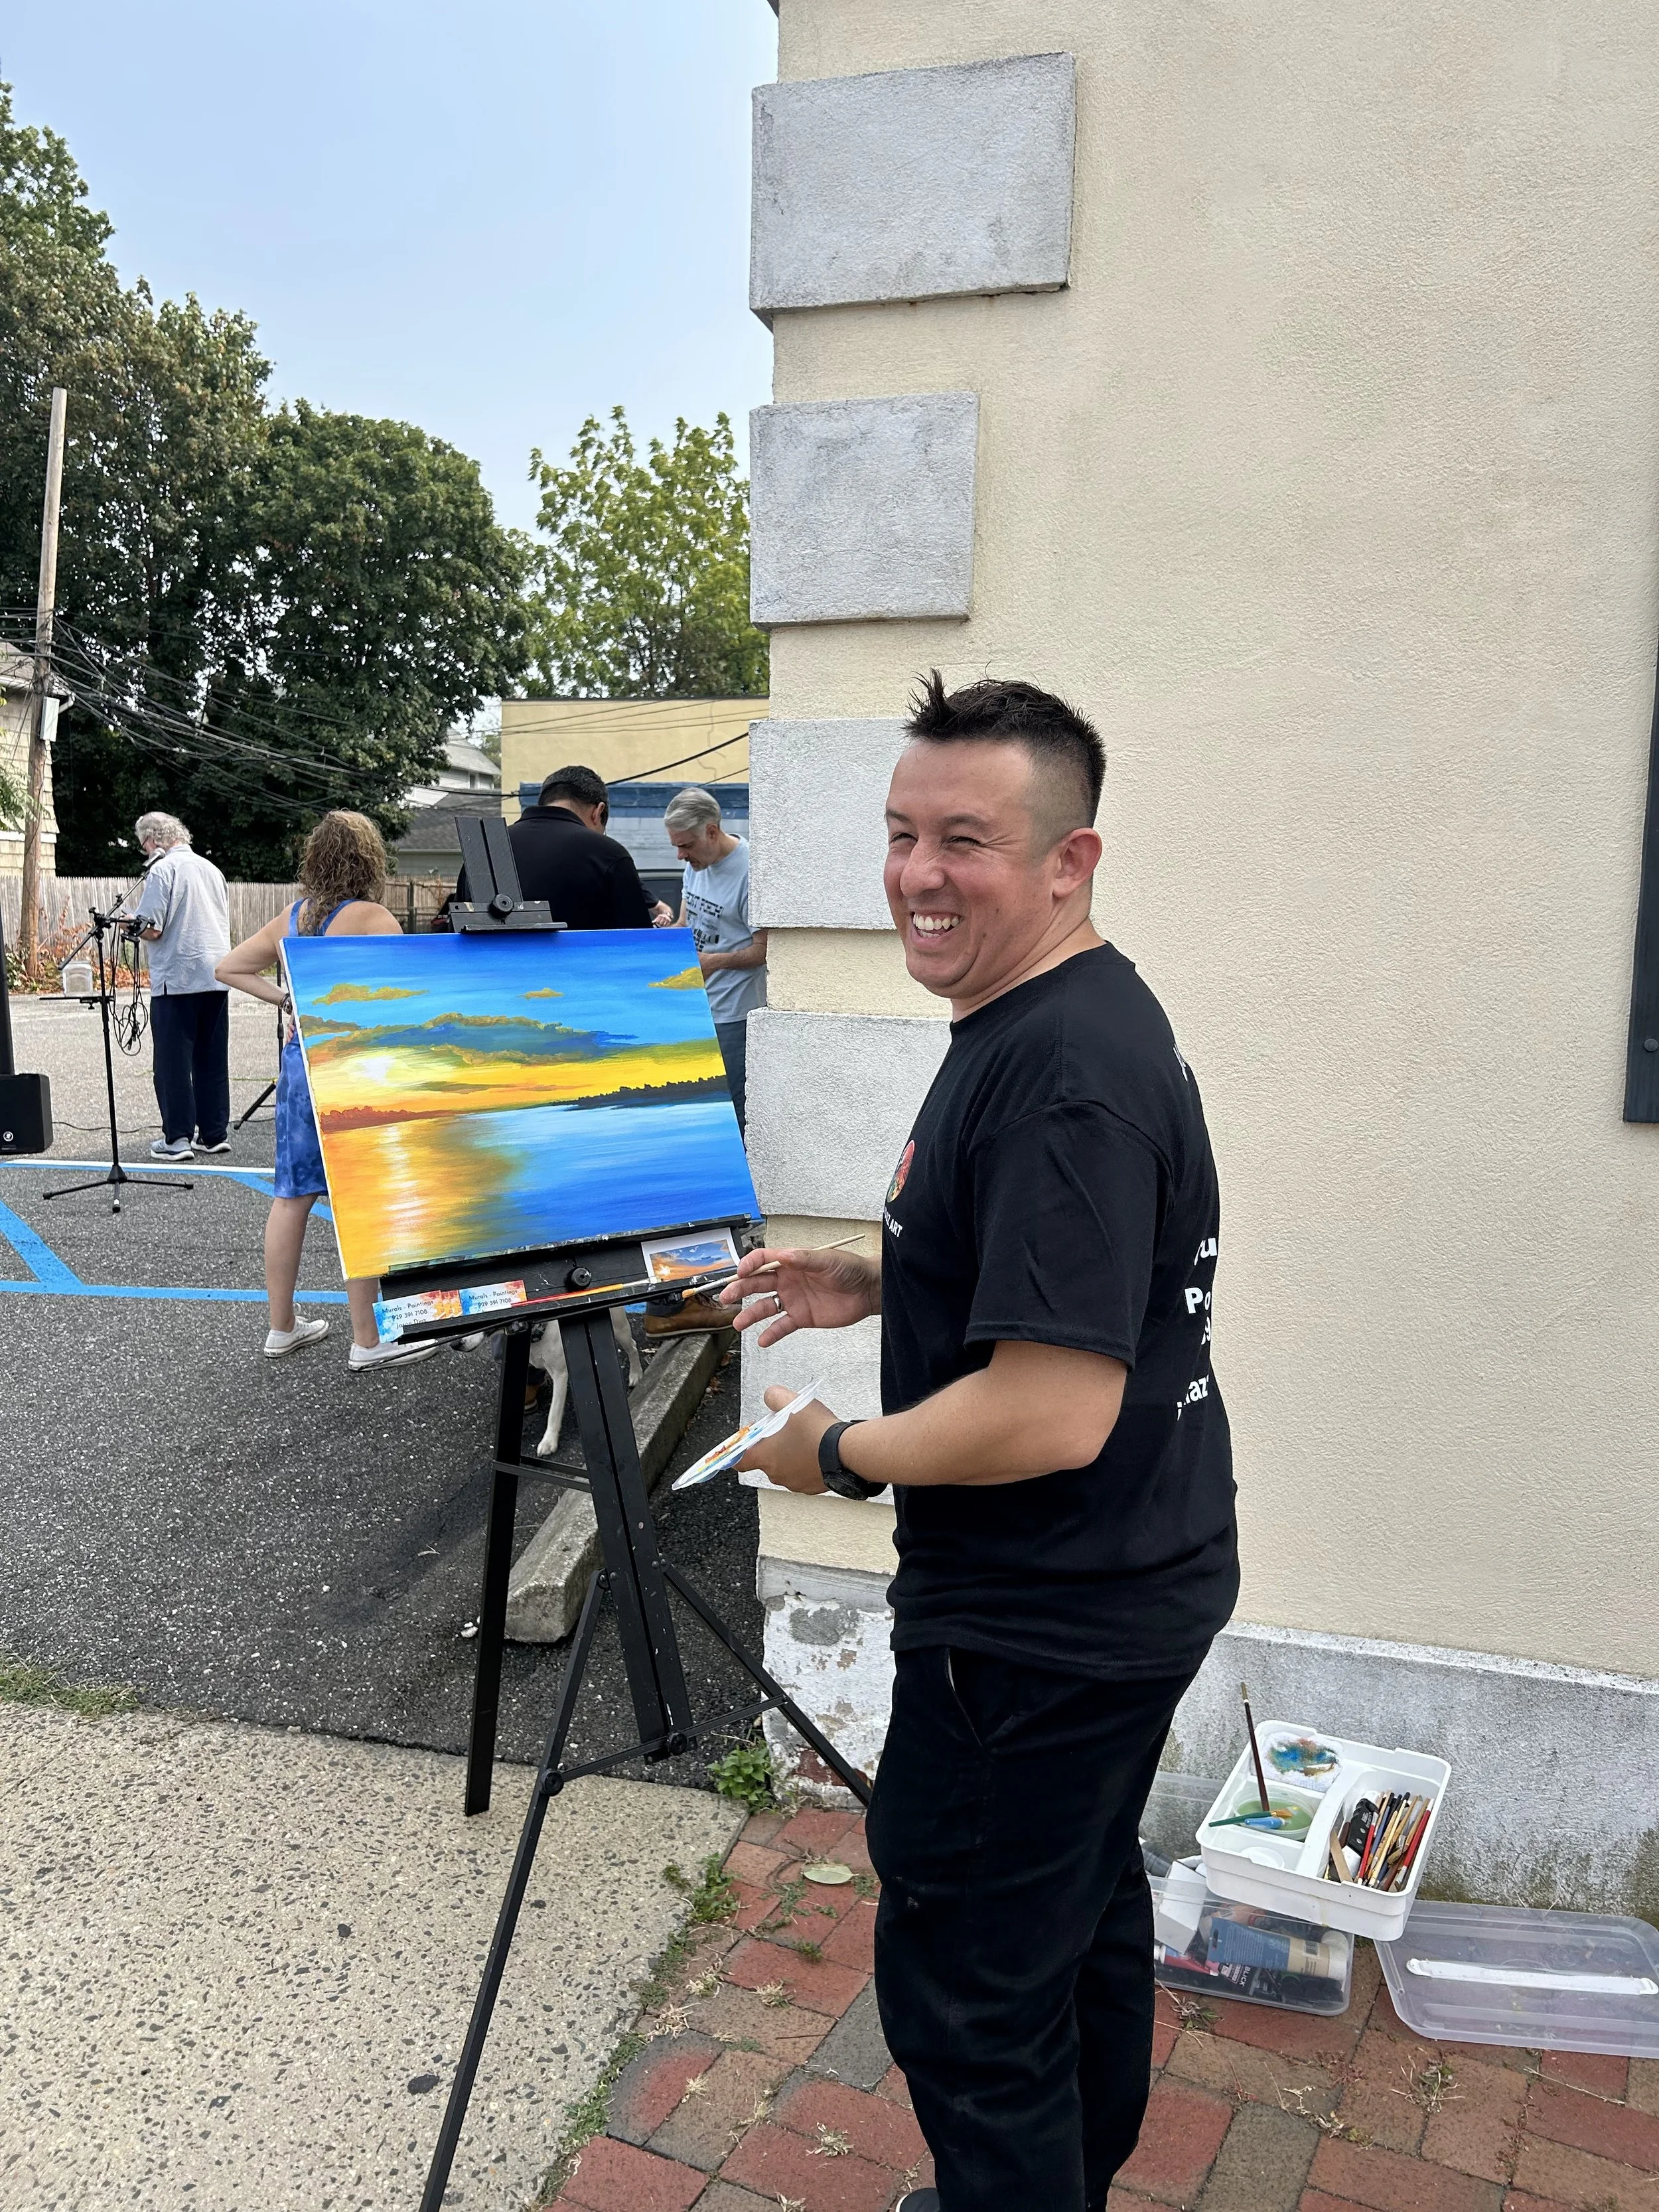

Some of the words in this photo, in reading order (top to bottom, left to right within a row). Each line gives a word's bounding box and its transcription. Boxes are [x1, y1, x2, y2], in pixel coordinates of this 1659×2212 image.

[889, 1218, 903, 1238] ART
[382, 1305, 402, 1314] Murals
[392, 1313, 403, 1322] 929
[1239, 1966, 1251, 1988] BLICK
